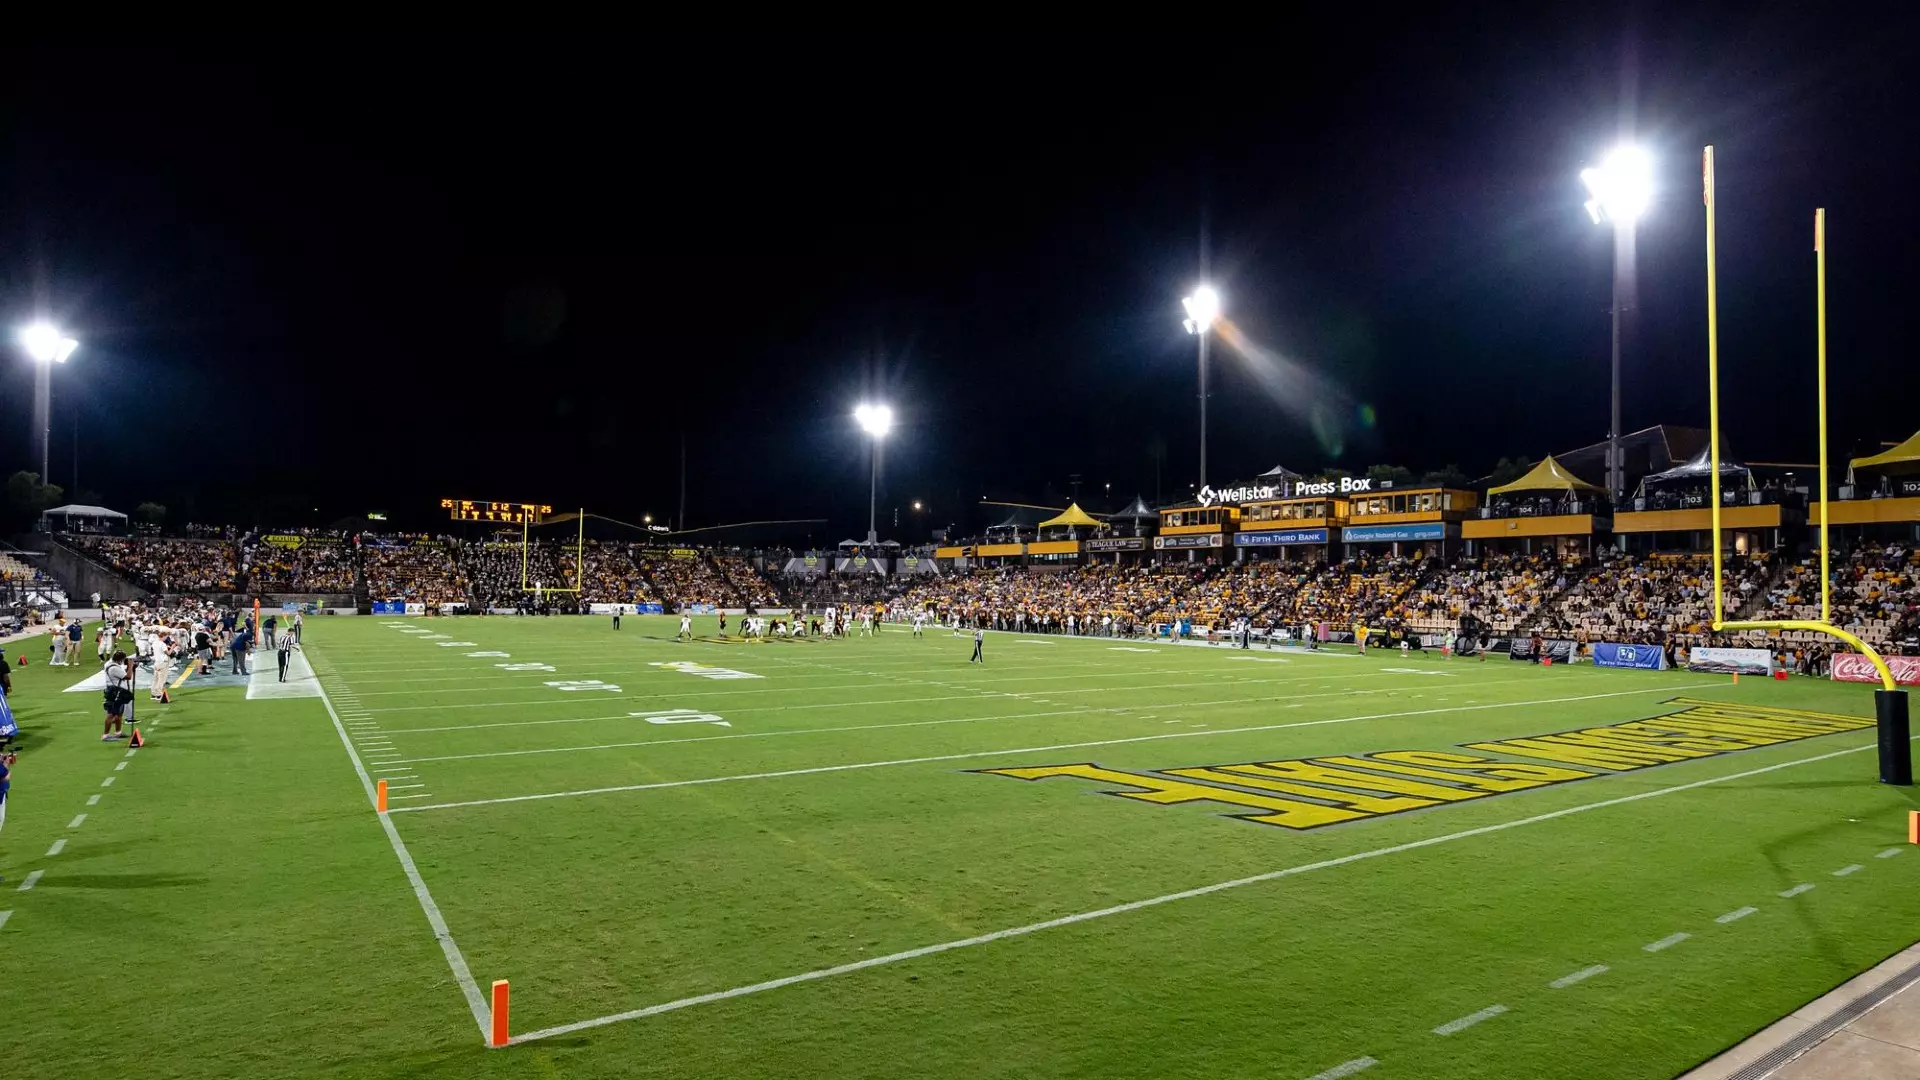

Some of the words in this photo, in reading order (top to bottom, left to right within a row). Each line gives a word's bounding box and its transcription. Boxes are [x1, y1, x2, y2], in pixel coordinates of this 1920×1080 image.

[1217, 486, 1273, 502] Wellstar
[1295, 481, 1336, 496] Press
[1340, 477, 1371, 492] Box
[1273, 534, 1296, 542] THIRD
[1298, 533, 1320, 541] BANK
